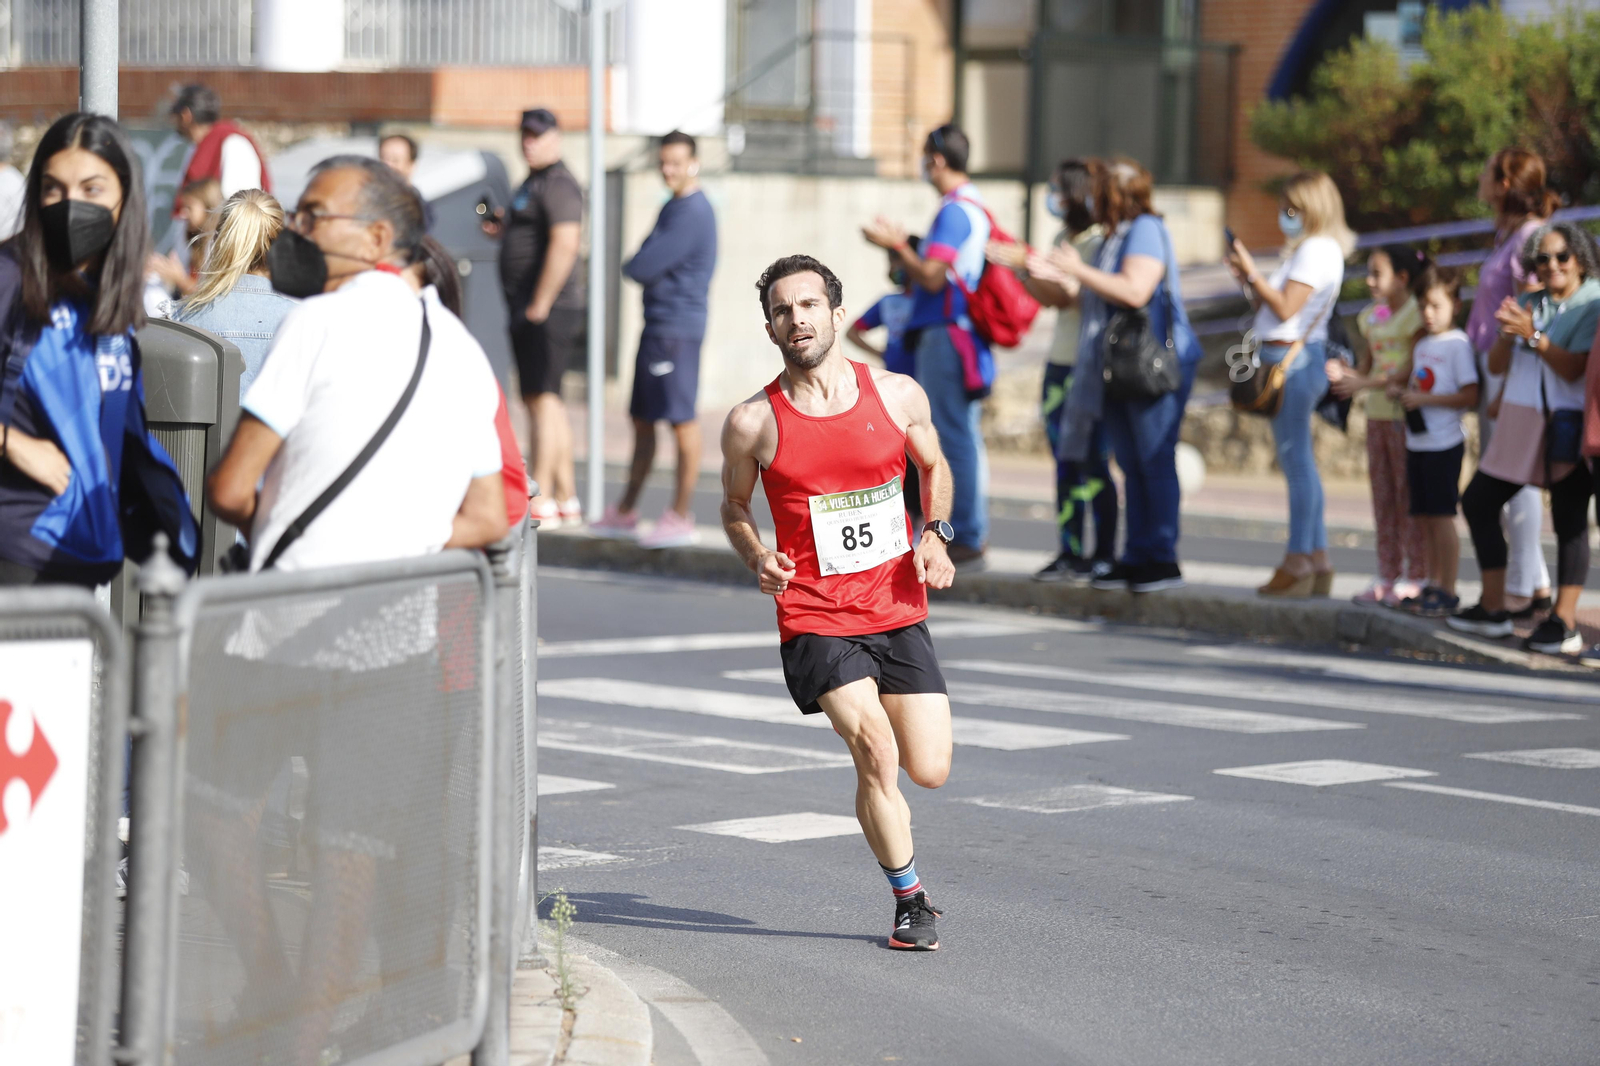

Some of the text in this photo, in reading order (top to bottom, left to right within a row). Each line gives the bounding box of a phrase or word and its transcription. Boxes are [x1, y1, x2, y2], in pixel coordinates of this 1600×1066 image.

[829, 495, 861, 509] VUELTA
[863, 494, 870, 504] A
[871, 483, 898, 503] HUELVA
[838, 510, 862, 518] RUBEN
[841, 522, 873, 551] 85
